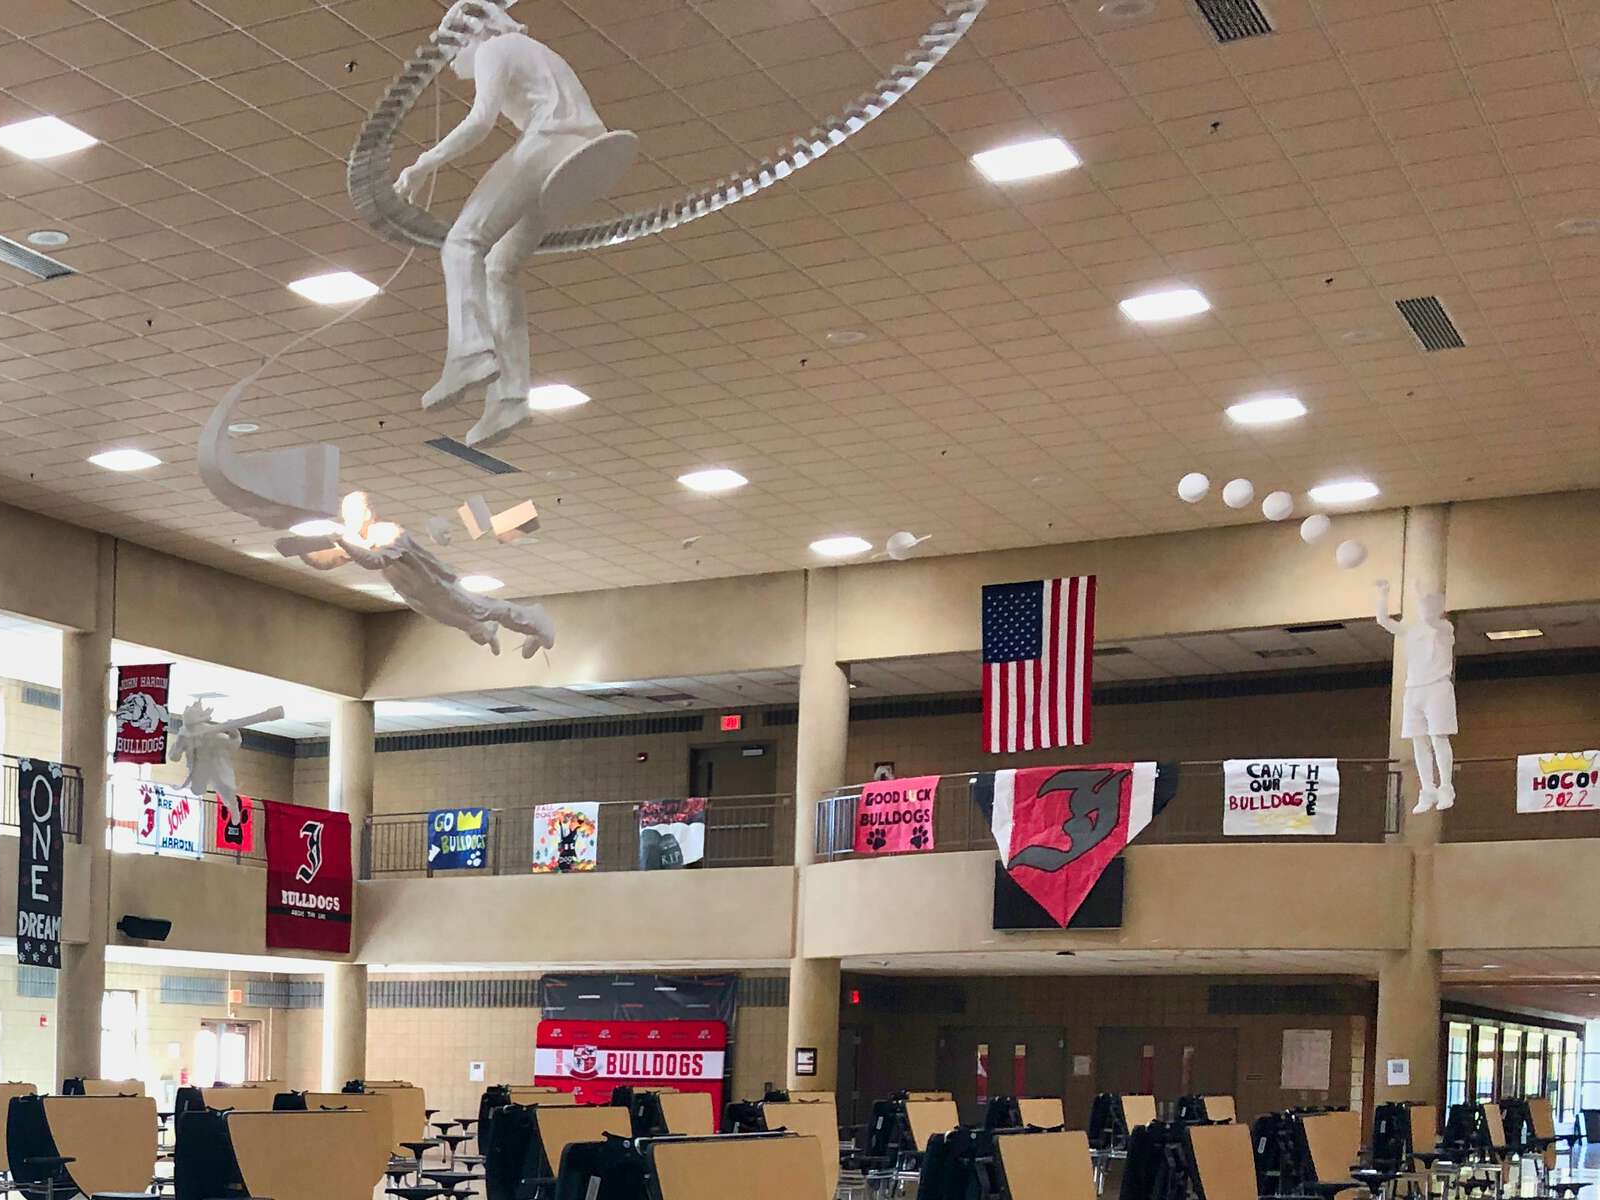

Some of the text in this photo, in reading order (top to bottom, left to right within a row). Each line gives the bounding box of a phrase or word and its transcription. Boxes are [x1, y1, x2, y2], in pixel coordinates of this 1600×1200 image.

[117, 736, 165, 754] BULLDOGS
[1249, 779, 1281, 792] OUR
[158, 798, 173, 810] ARE
[865, 788, 932, 806] GOOD LUCK
[1229, 792, 1304, 810] BULLDOG
[1543, 790, 1594, 809] 2022
[168, 796, 190, 836] JOHN
[434, 812, 455, 832] GO
[860, 808, 930, 826] BULLDOGS
[30, 774, 53, 902] ONE
[162, 836, 195, 852] HARDIN
[281, 889, 341, 912] BULLDOGS
[18, 910, 62, 943] DREAM
[606, 1052, 704, 1077] BULLDOGS
